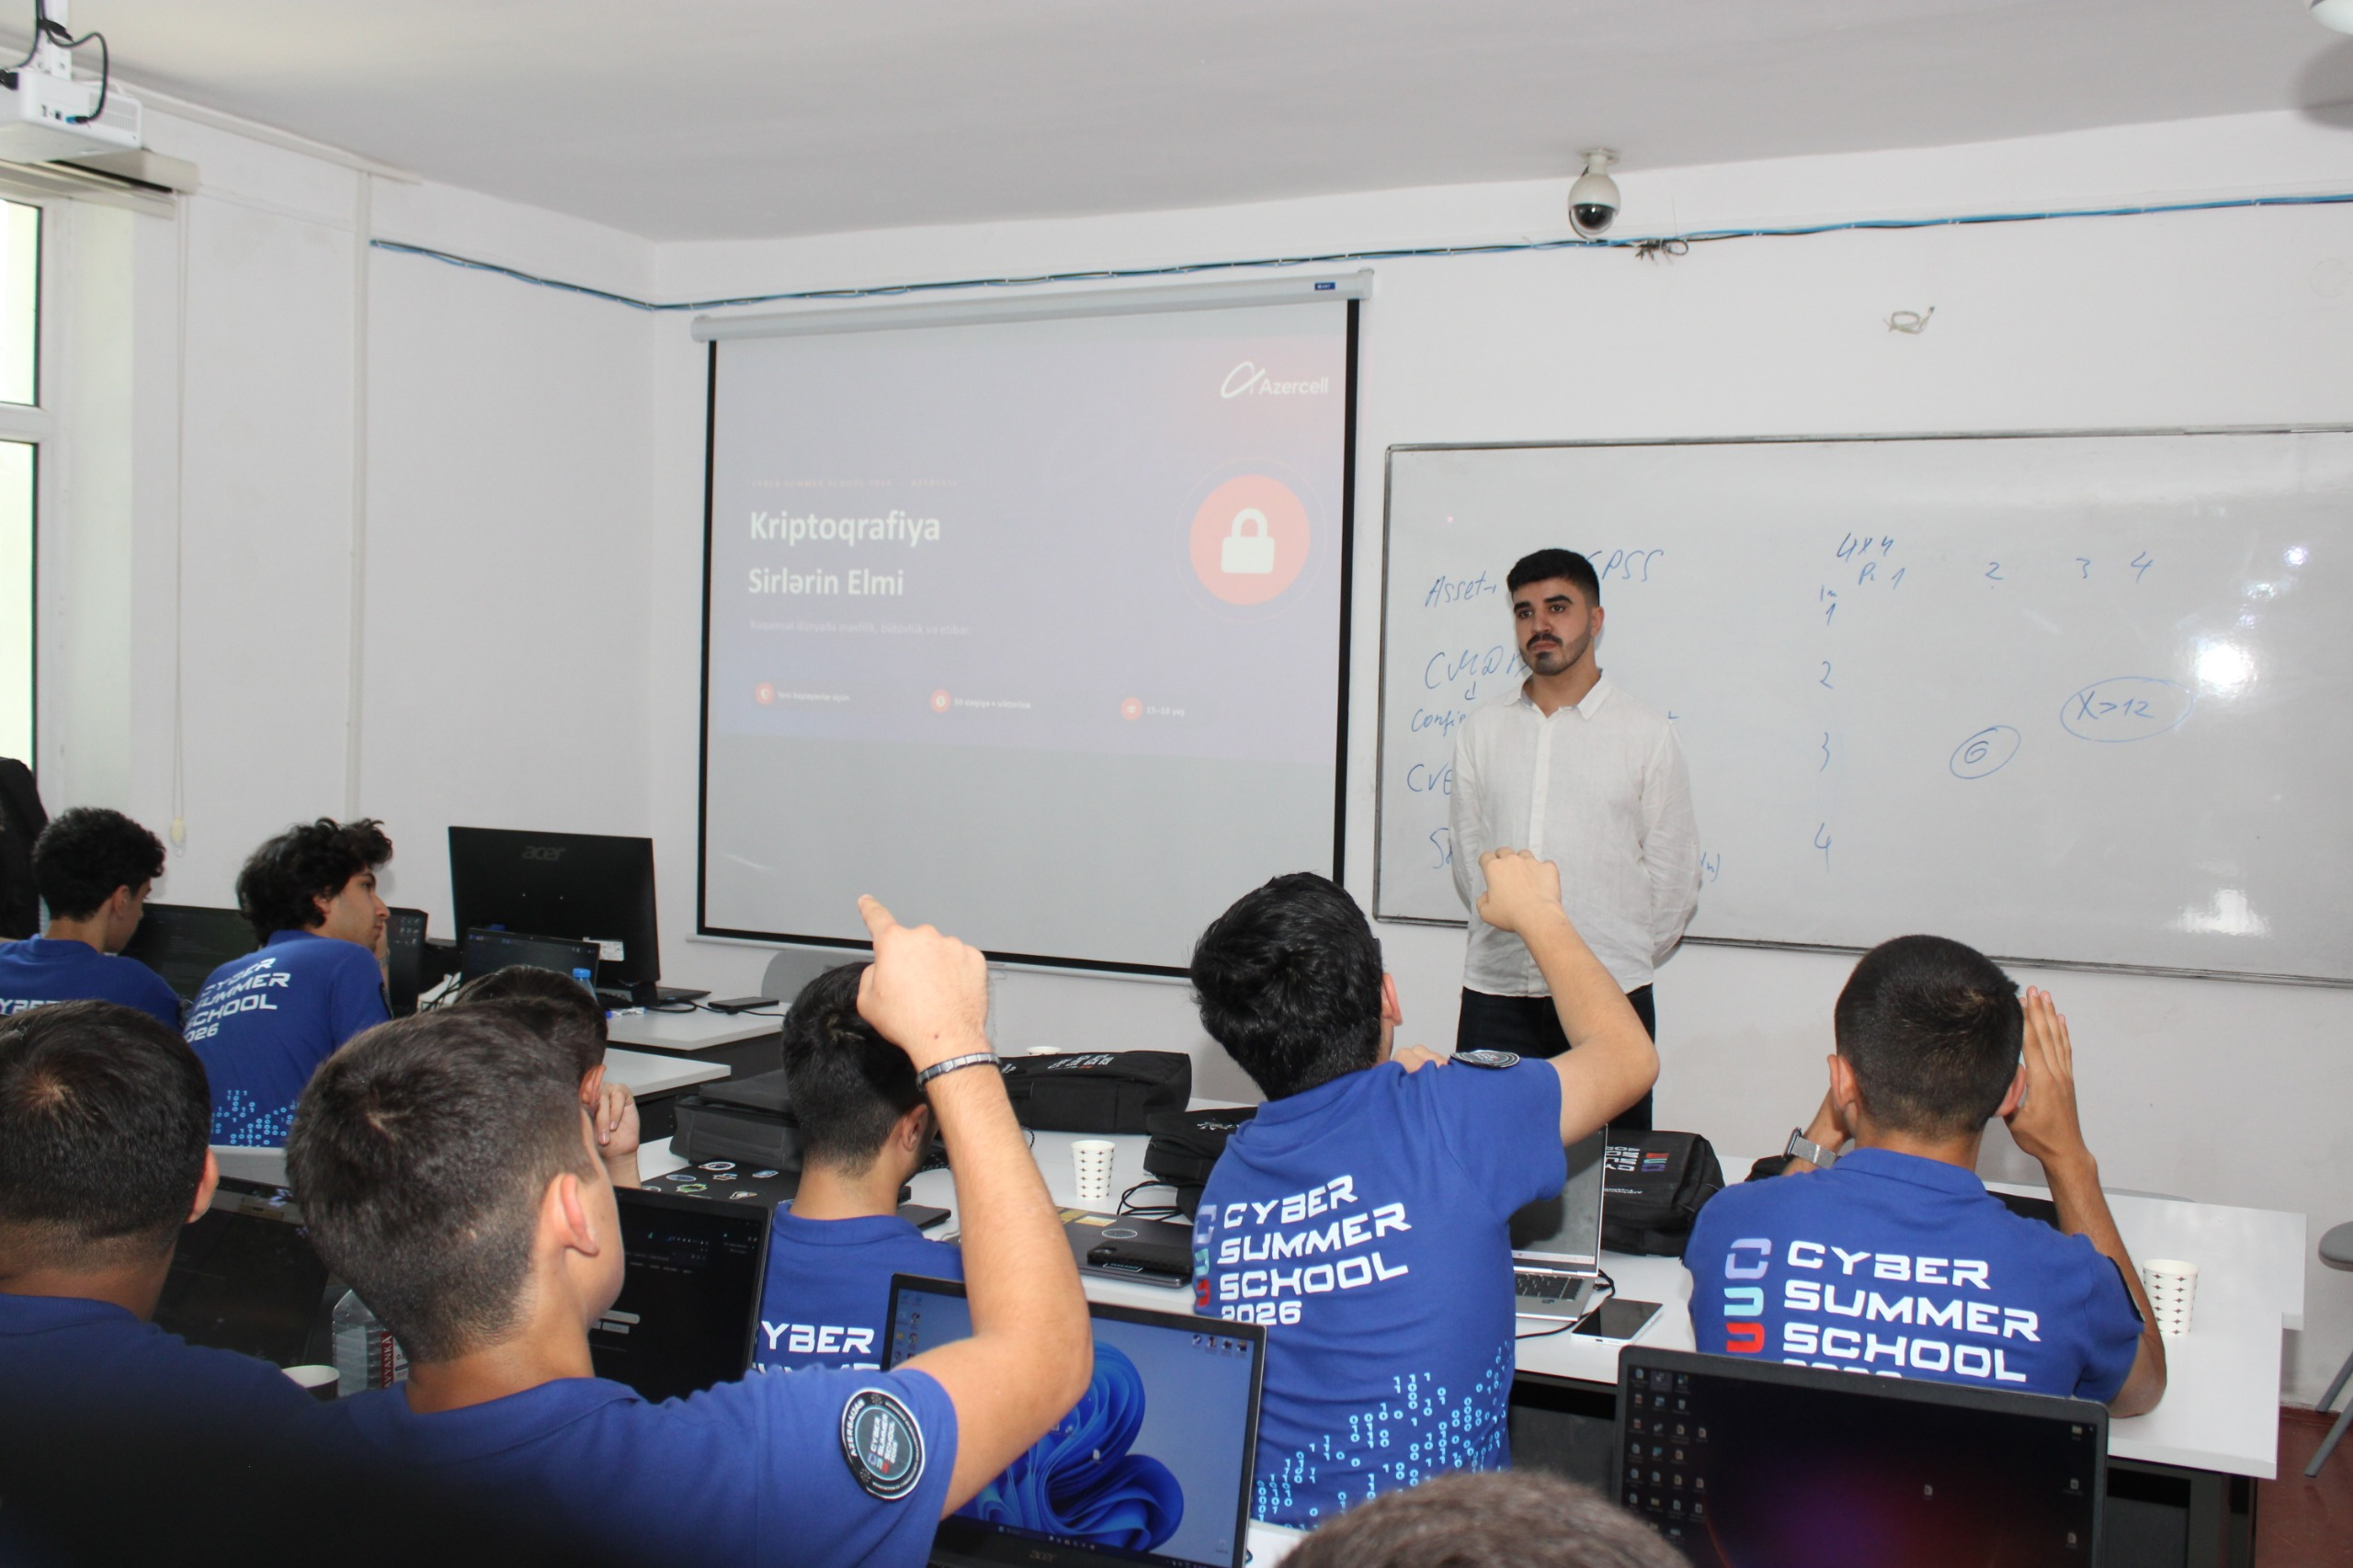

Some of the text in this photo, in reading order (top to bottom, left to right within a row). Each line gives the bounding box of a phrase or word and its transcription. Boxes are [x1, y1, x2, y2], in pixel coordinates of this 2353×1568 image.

[1258, 377, 1329, 395] Azercell
[750, 509, 941, 548] Kriptoqrafiya
[748, 566, 904, 597] Sirlərin Elmi
[1586, 550, 1665, 582] PSS
[1891, 567, 1905, 590] 1
[1984, 562, 2005, 581] 2
[2075, 557, 2091, 580] 3
[2130, 551, 2154, 584] 4
[1825, 602, 1836, 626] 1
[1820, 660, 1834, 689] 2
[1819, 732, 1830, 773] 3
[522, 846, 566, 861] acer
[1813, 823, 1832, 873] 4
[184, 1022, 220, 1043] 026
[1223, 1175, 1358, 1229] CYBER
[1217, 1202, 1413, 1265] SUMMER
[1220, 1252, 1409, 1301] SCHOOL
[1787, 1240, 1991, 1290] CYBER
[1222, 1301, 1302, 1325] 2026
[1784, 1279, 2041, 1342] SUMMER
[761, 1321, 874, 1354] YBER
[1783, 1322, 2027, 1383] SCHOOL
[846, 1398, 865, 1458] AZERBAIJAN
[870, 1416, 881, 1453] CYBER
[877, 1413, 889, 1457] SUMMER
[883, 1422, 895, 1460] SCHOOL
